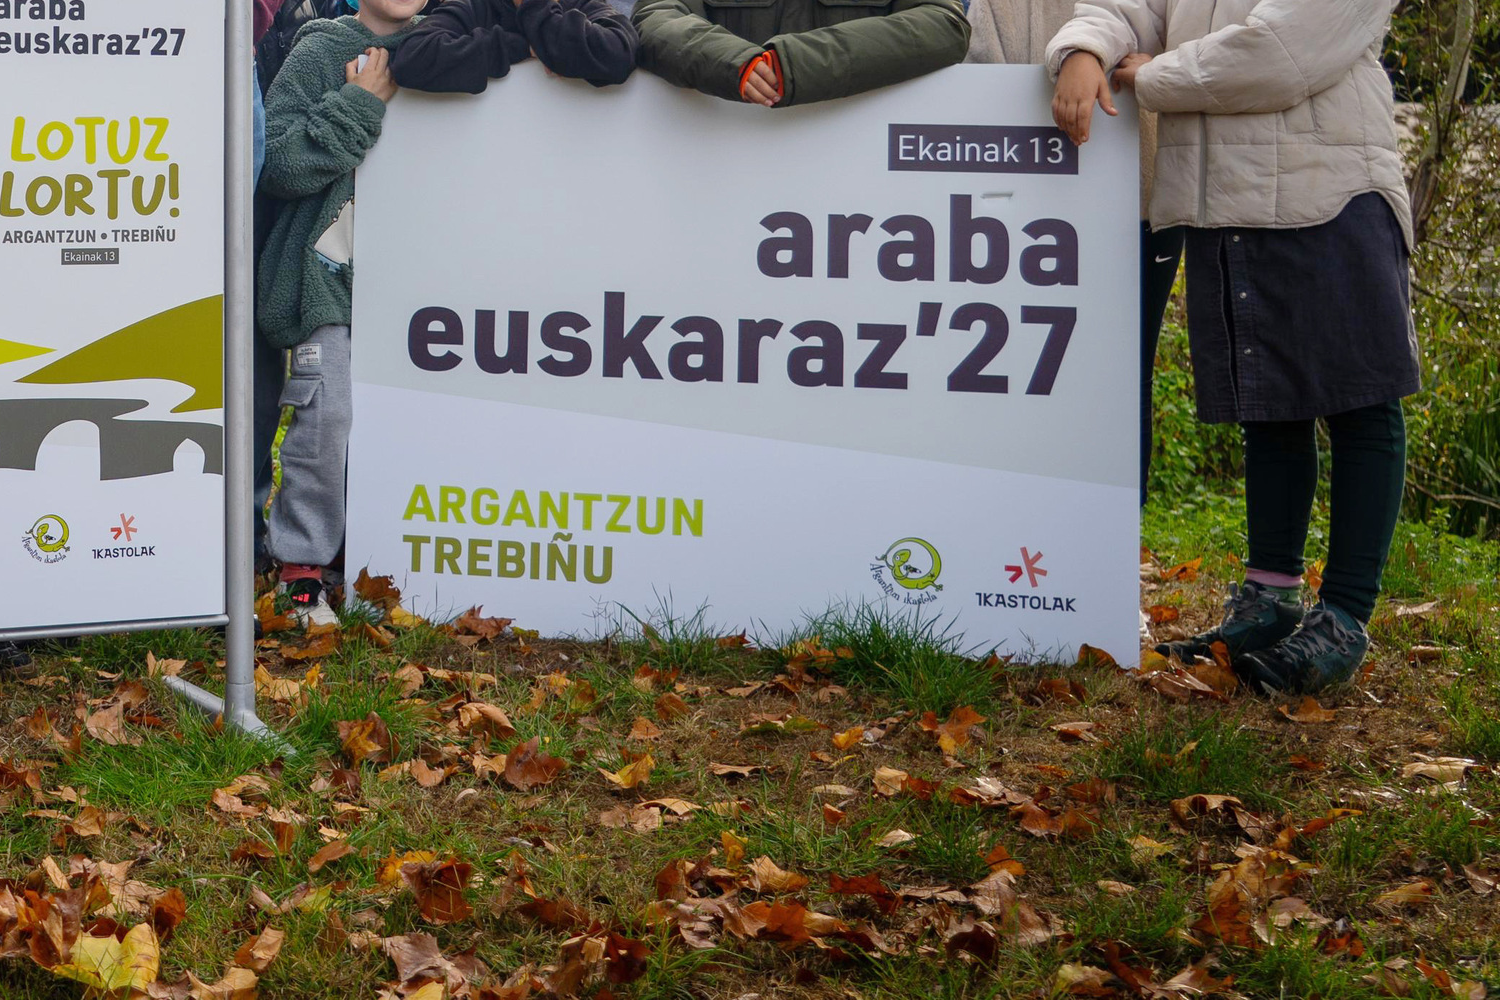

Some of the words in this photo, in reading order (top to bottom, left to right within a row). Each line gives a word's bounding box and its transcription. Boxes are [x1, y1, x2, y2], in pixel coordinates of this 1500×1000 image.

[11, 116, 170, 164] LOTUZ
[898, 135, 1020, 164] Ekainak
[1028, 136, 1065, 165] 13
[0, 164, 180, 221] LORTU!
[2, 230, 97, 244] ARGANTZUN
[111, 225, 176, 243] TREBIÑU
[64, 252, 101, 261] Ekainak
[104, 251, 116, 261] 13
[757, 194, 1080, 287] araba
[407, 291, 1078, 397] euskaraz'27
[403, 485, 704, 538] ARGANTZUN
[403, 531, 614, 584] TREBIÑU
[870, 563, 901, 601] Argantzun
